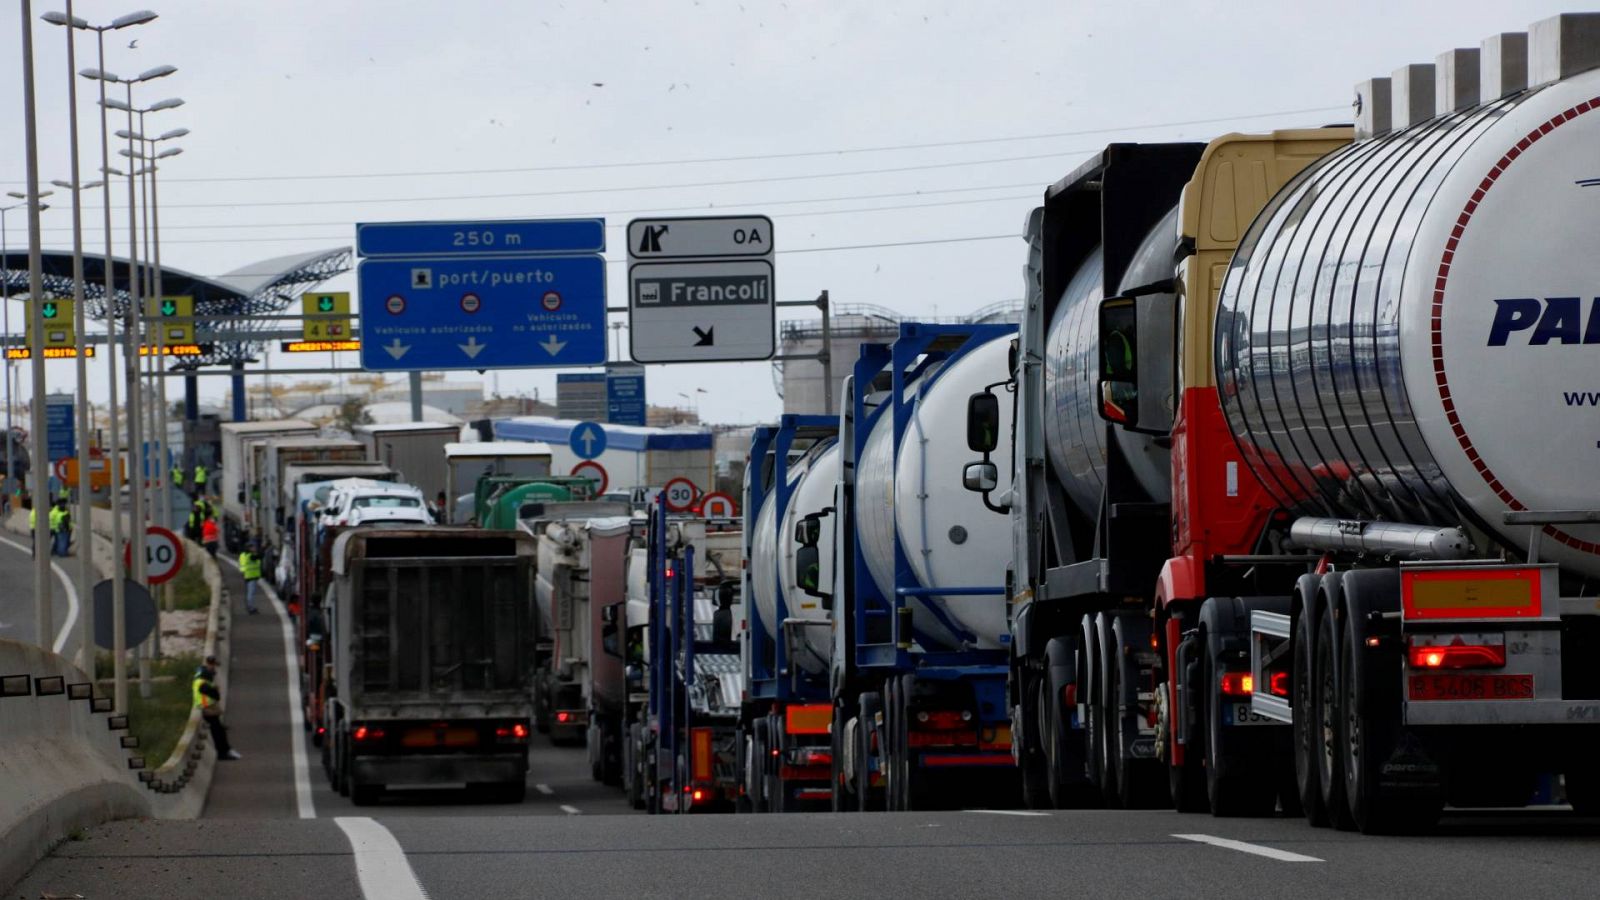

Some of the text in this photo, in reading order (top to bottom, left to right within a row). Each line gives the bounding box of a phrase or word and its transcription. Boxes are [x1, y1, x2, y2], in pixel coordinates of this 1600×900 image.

[453, 231, 521, 246] 250 m
[439, 269, 554, 288] port/puerto
[671, 279, 766, 302] Francolí
[430, 324, 493, 333] autorizados
[513, 323, 592, 332] no autorizados
[671, 488, 690, 501] 30
